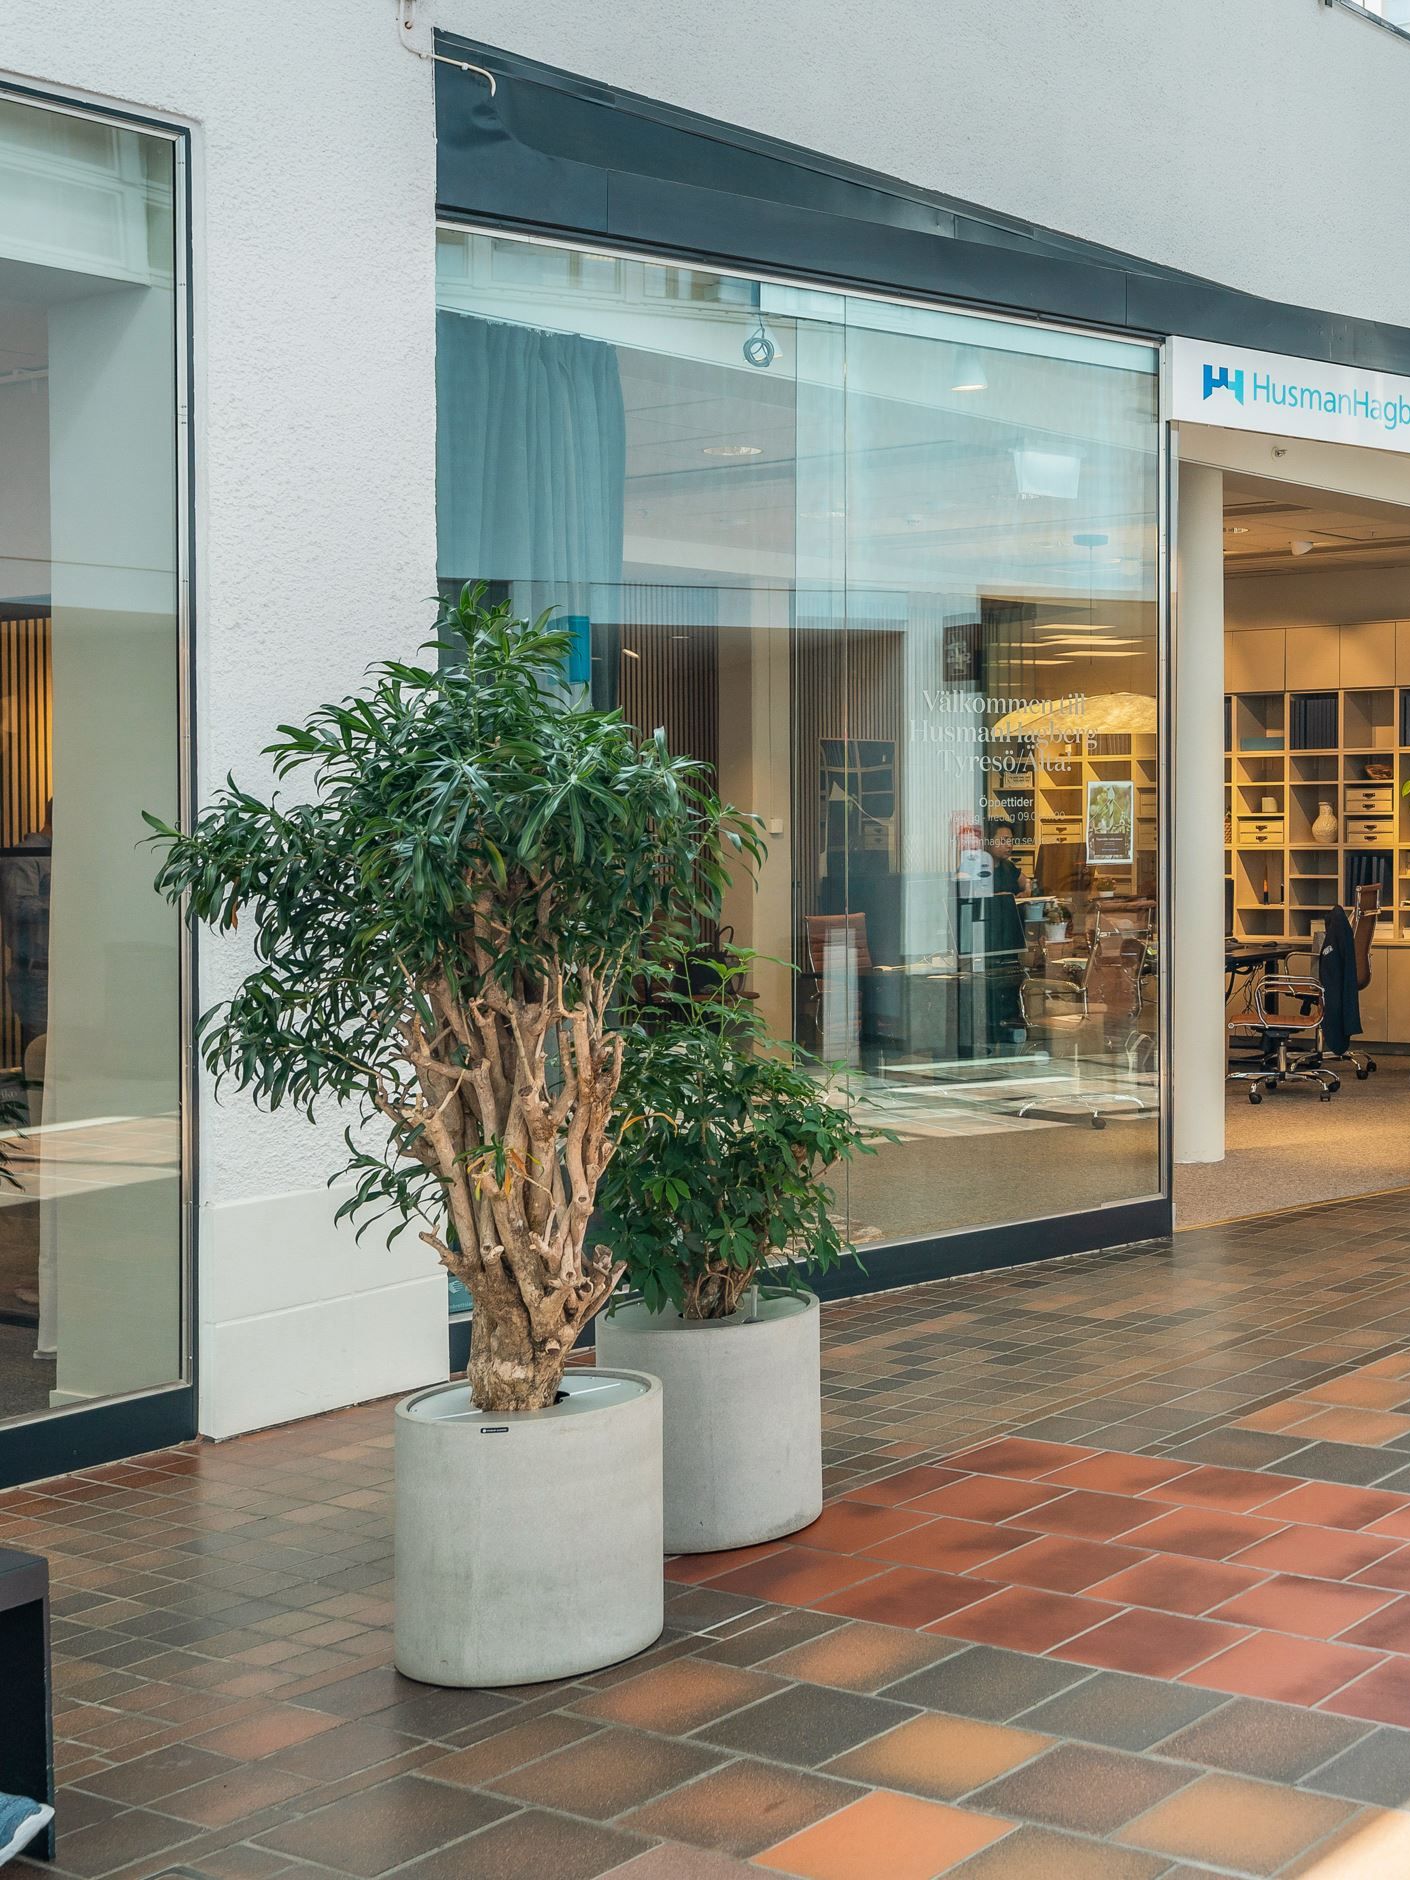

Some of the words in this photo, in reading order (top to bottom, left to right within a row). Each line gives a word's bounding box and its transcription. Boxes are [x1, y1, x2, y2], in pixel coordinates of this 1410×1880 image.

[922, 689, 1053, 714] Välkommen
[1059, 692, 1086, 716] till
[937, 744, 1073, 777] Tyresö/Älta!
[979, 794, 1034, 809] Öppettider
